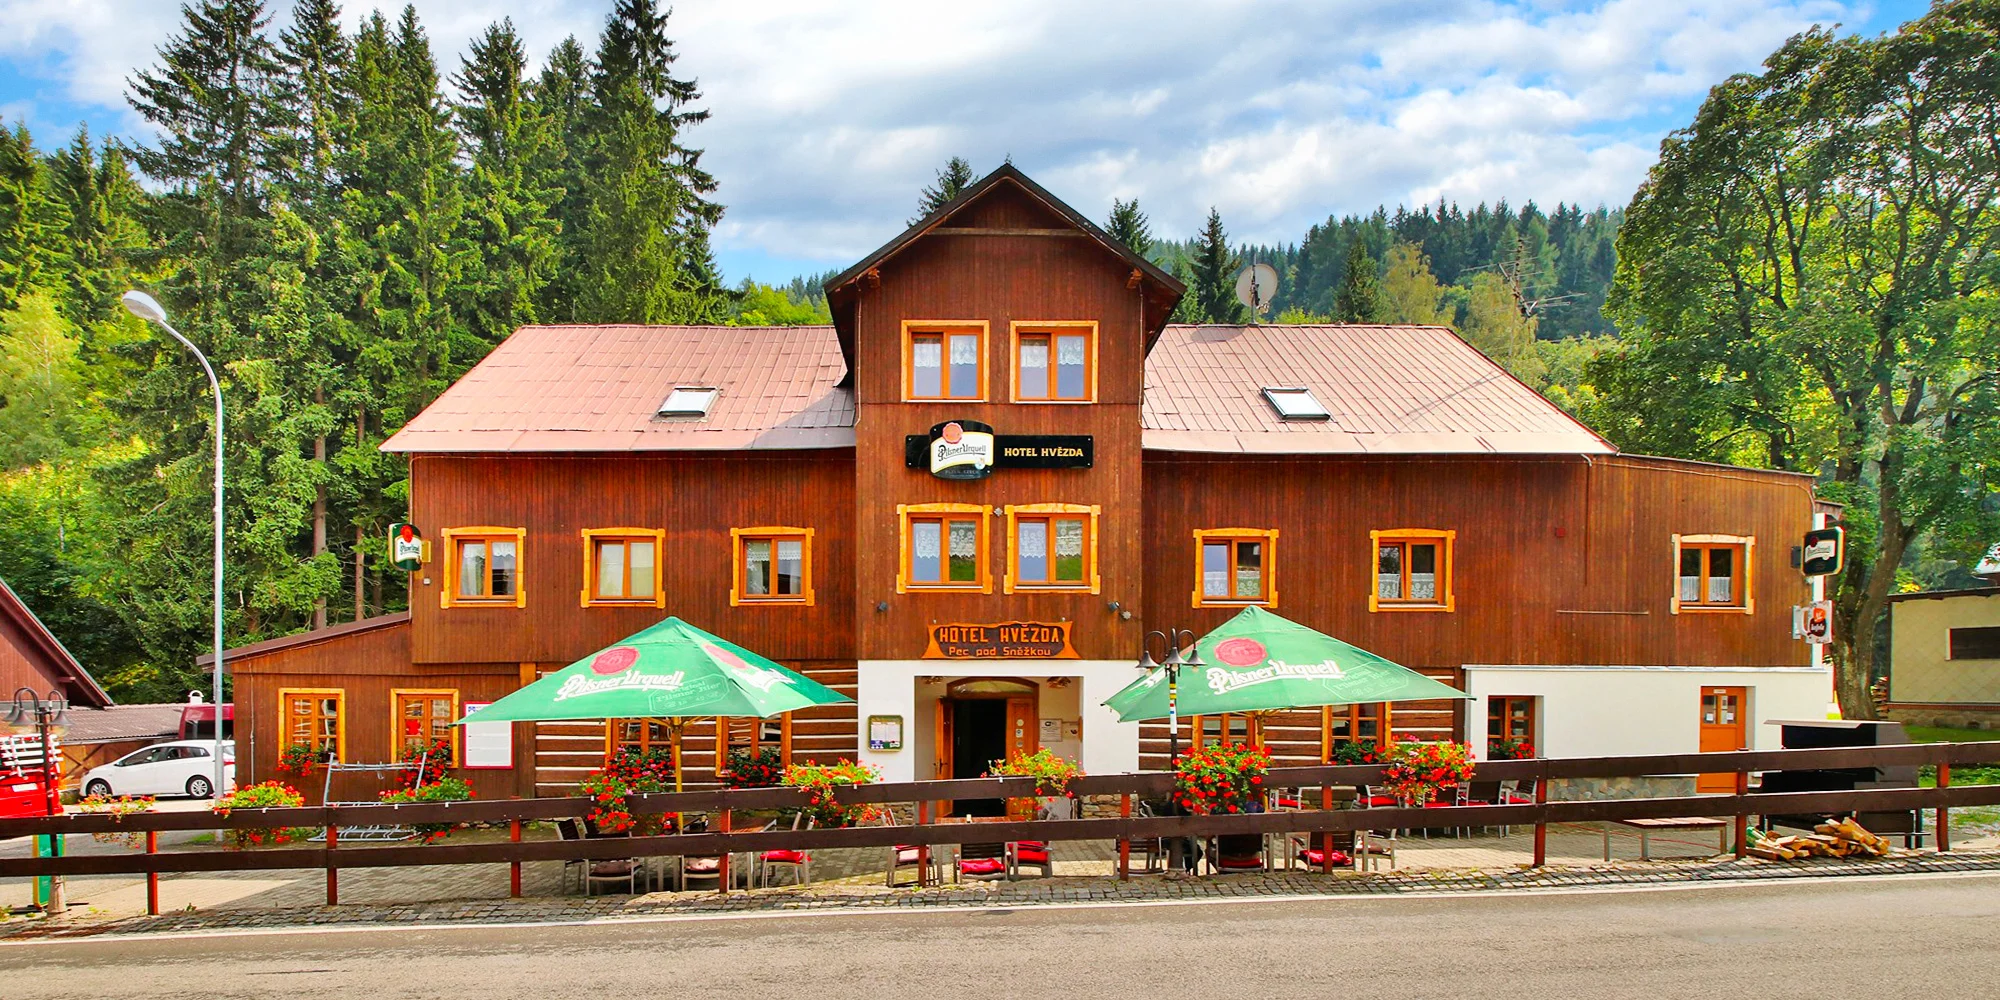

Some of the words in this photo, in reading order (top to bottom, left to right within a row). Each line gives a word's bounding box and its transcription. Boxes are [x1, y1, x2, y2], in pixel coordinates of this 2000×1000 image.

[1004, 447, 1038, 457] HOTEL
[1041, 446, 1084, 457] HVĚZDA
[939, 627, 989, 643] HOTEL
[1000, 624, 1060, 643] HVĚZDA
[948, 646, 969, 656] Pec
[975, 646, 997, 657] pod
[1003, 646, 1051, 656] Sněžkou
[553, 674, 626, 701] Pilsner
[620, 669, 685, 692] Urquell
[1206, 667, 1275, 695] Pilsner
[1268, 659, 1343, 681] Urquell
